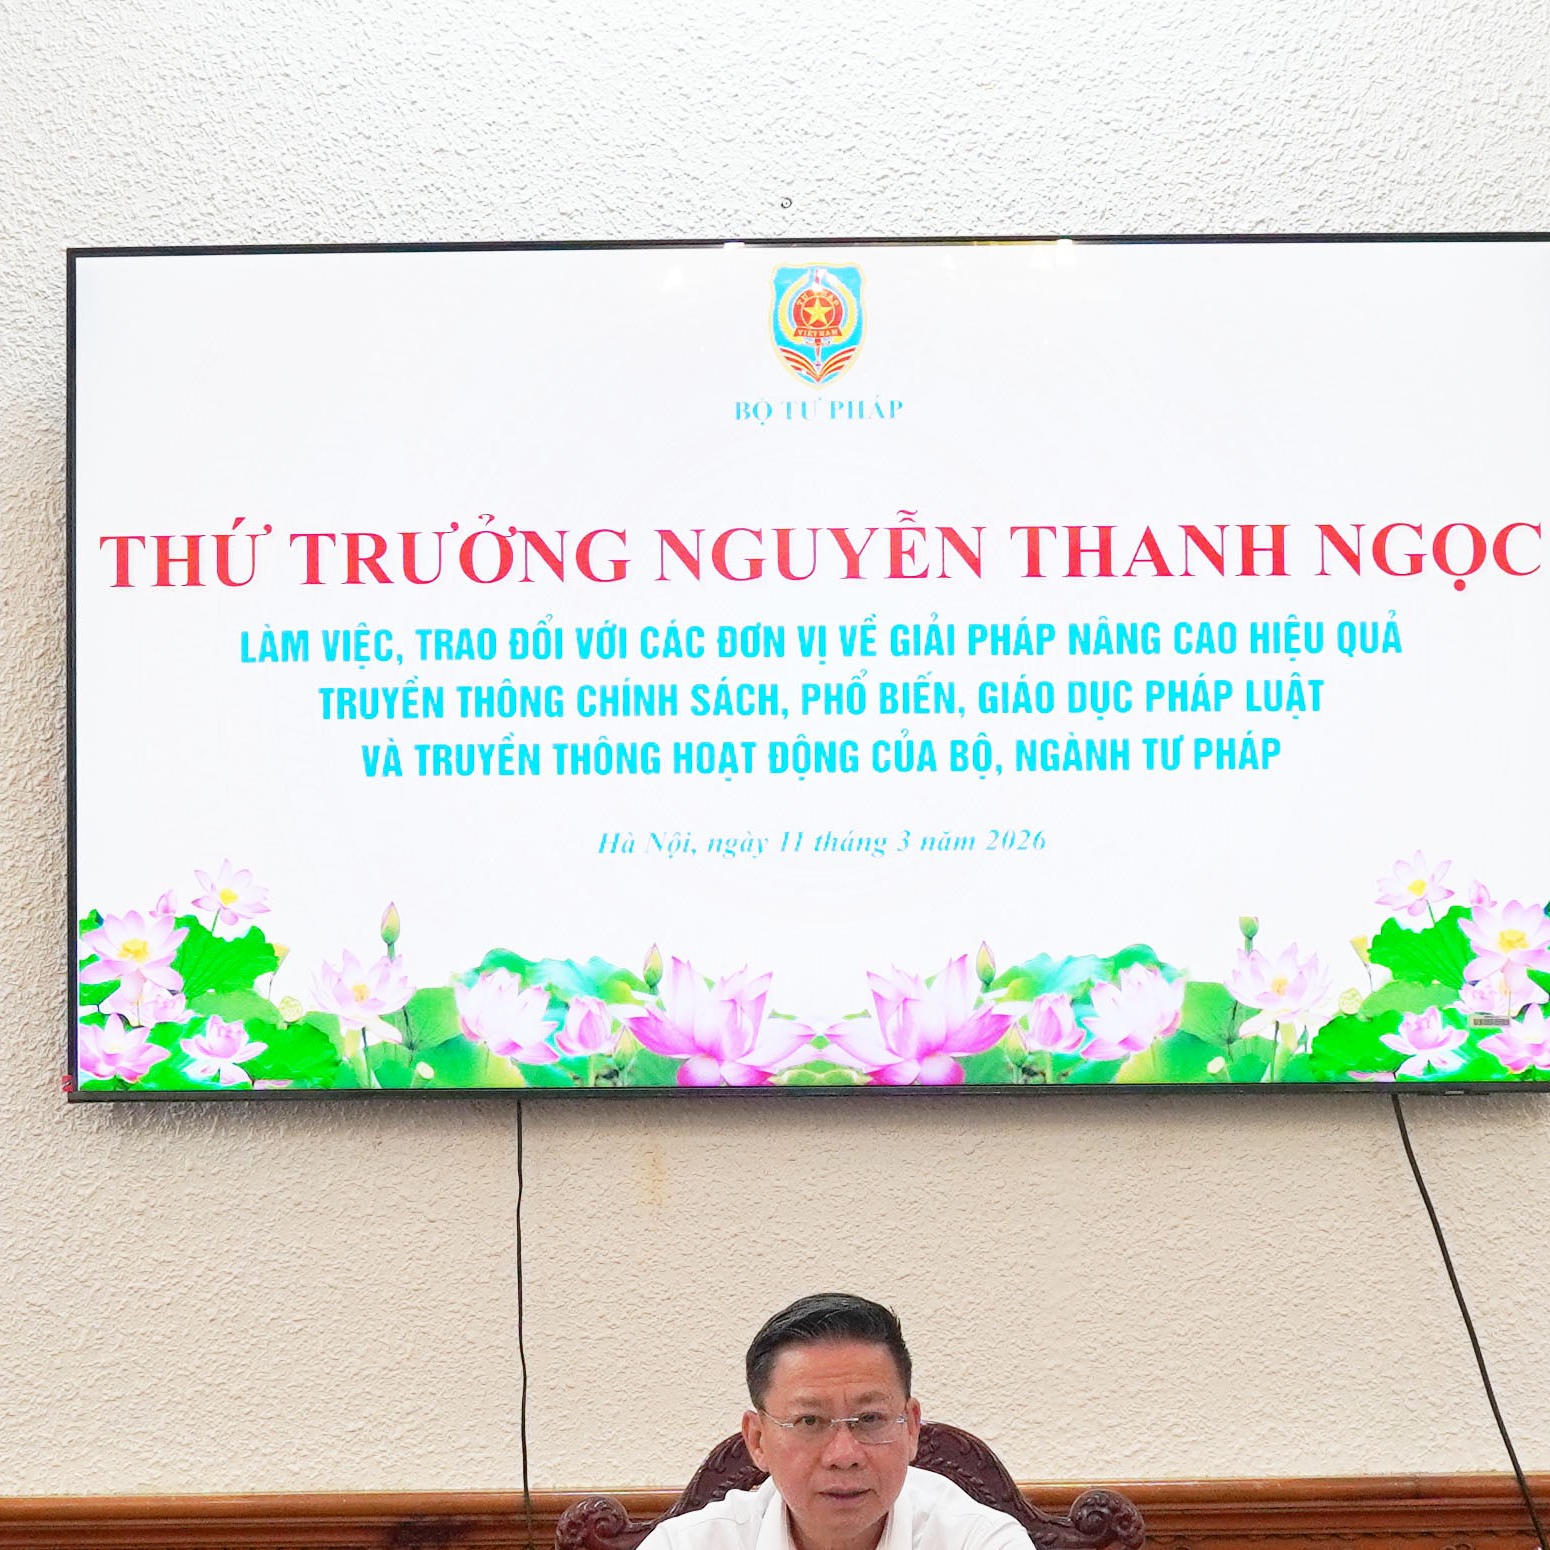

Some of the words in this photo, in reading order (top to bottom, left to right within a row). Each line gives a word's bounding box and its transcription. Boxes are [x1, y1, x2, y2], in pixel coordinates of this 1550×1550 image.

[734, 398, 774, 426] BỘ
[829, 394, 905, 421] PHÁP
[100, 517, 272, 587] THỨ
[290, 512, 629, 584] TRƯỞNG
[656, 508, 985, 581] NGUYỄN
[1010, 525, 1289, 577] THANH
[1315, 522, 1541, 591] NGỌC
[241, 624, 309, 663] LÀM
[322, 622, 403, 669] VIỆC,
[415, 628, 497, 661] TRAO
[509, 614, 563, 660] ĐỔI
[575, 620, 627, 660] VỚI
[640, 619, 705, 659] CÁC
[716, 622, 785, 658] ĐƠN
[797, 625, 826, 665] VỊ
[839, 614, 877, 657] VỀ
[890, 612, 955, 657] GIẢI
[968, 616, 1056, 656] PHÁP
[1068, 616, 1160, 655] NÂNG
[1174, 621, 1237, 655] CAO
[1250, 614, 1324, 662] HIỆU
[1337, 610, 1402, 658] QUẢ
[318, 675, 444, 720] TRUYỀN
[456, 678, 564, 718] THÔNG
[577, 677, 678, 718] CHÍNH
[690, 676, 788, 719] SÁCH,
[802, 669, 867, 715] PHỔ
[879, 672, 965, 717] BIẾN,
[978, 674, 1054, 714] GIÁO
[1068, 680, 1132, 720] DỤC
[1146, 672, 1233, 712] PHÁP
[1246, 672, 1325, 720] LUẬT
[362, 738, 403, 777] VÀ
[414, 732, 540, 776] TRUYỀN
[552, 736, 660, 776] THÔNG
[673, 741, 757, 782] HOẠT
[768, 733, 859, 781] ĐỘNG
[872, 728, 937, 773] CỦA
[950, 732, 1002, 780] BỘ,
[1016, 732, 1130, 772] NGÀNH
[1142, 734, 1184, 771] TƯ
[1194, 730, 1281, 770] PHÁP
[598, 832, 636, 854] Hà
[646, 831, 697, 859] Nội,
[707, 832, 769, 860] ngày
[780, 831, 804, 852] 11
[813, 829, 888, 858] tháng
[897, 829, 912, 852] 3
[920, 831, 976, 852] năm
[985, 829, 1047, 851] 2026
